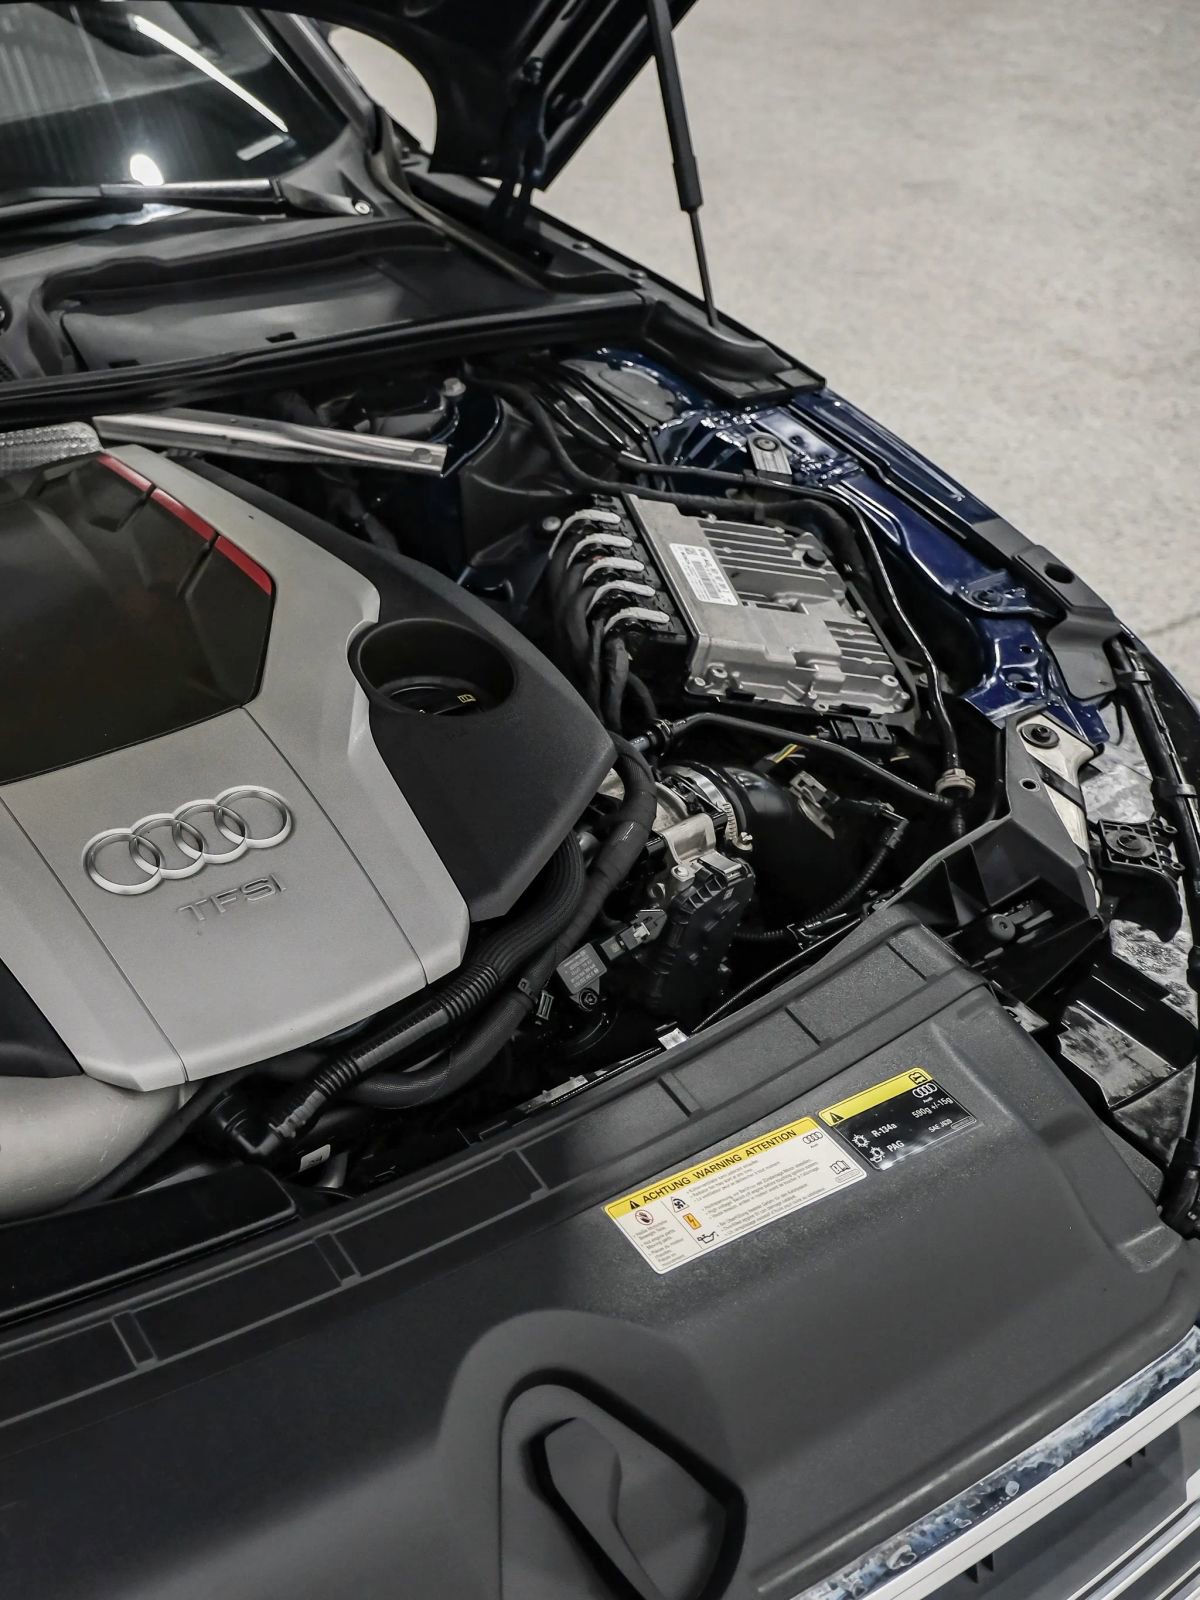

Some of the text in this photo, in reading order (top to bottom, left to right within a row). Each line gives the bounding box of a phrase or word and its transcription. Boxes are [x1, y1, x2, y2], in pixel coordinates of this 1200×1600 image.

[177, 873, 287, 921] TFSI
[871, 1122, 898, 1138] R-134a
[886, 1140, 905, 1153] PAG
[642, 1177, 691, 1203] ACHTUNG
[692, 1153, 743, 1180] WARNING
[745, 1129, 797, 1157] ATTENTION
